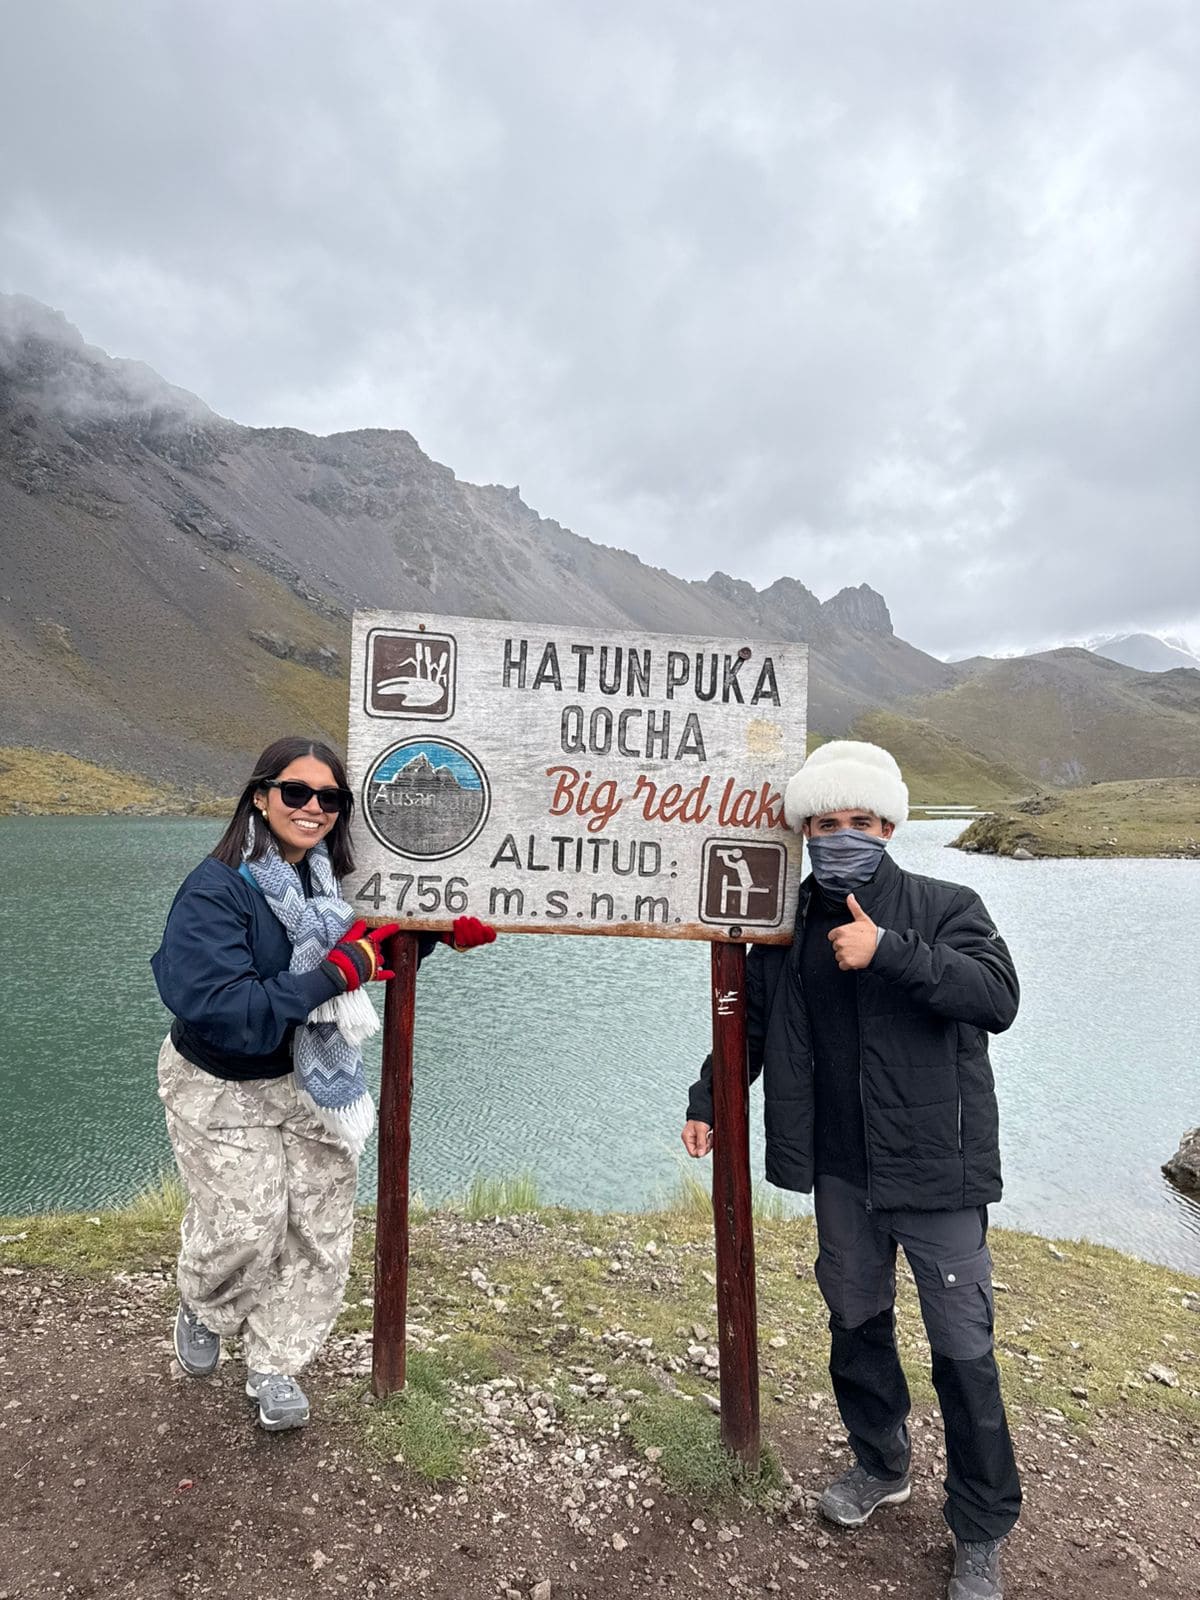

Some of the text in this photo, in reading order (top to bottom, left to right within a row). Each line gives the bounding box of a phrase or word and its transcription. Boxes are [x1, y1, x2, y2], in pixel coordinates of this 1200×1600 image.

[501, 639, 781, 707] HATUN PUKA
[560, 704, 707, 762] QOCHA
[545, 765, 623, 833] Big
[632, 774, 712, 824] red
[489, 833, 678, 878] ALTITUD:
[355, 872, 681, 924] 4756 m.s.n.m.
